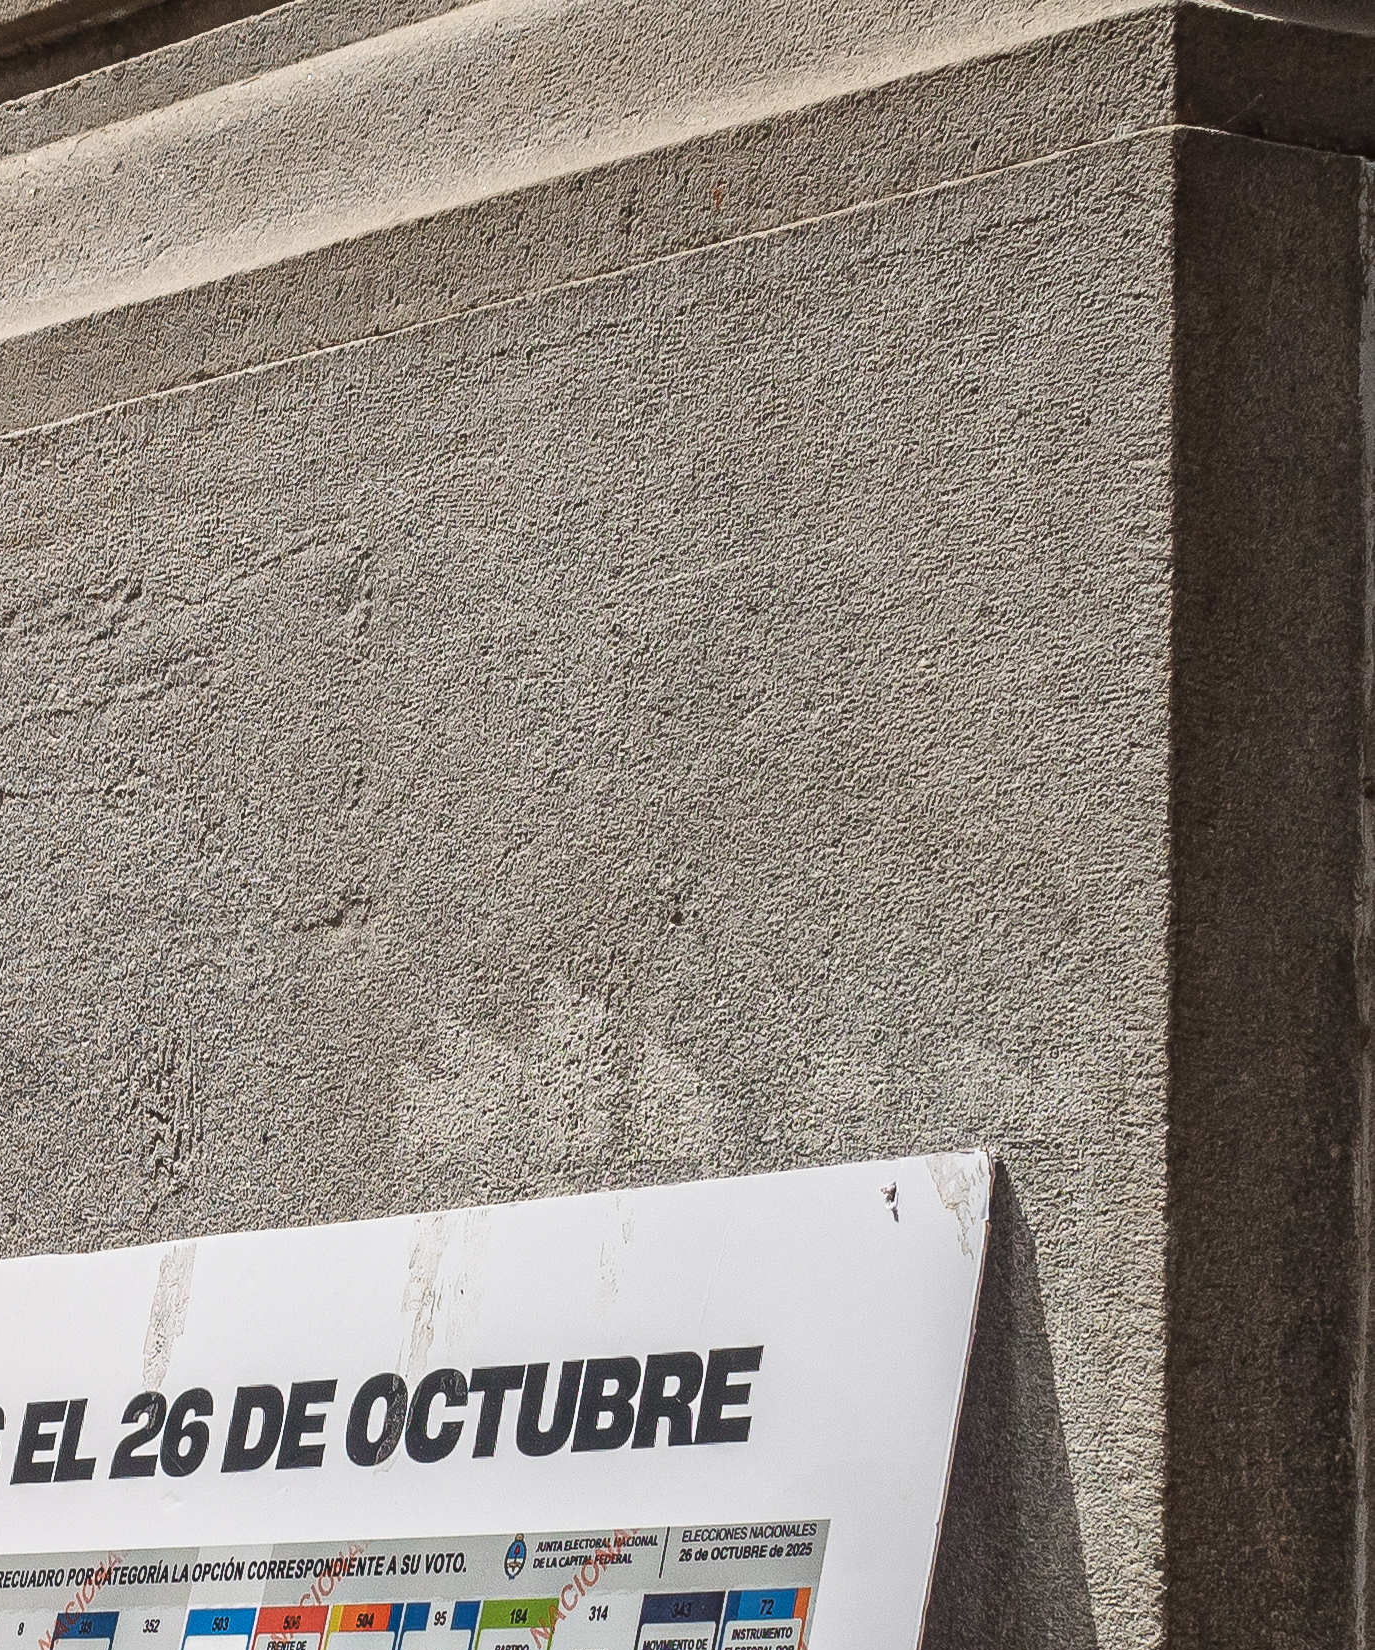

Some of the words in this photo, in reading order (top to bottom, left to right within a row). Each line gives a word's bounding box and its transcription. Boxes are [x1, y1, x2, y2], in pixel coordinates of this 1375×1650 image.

[10, 1398, 97, 1485] EL
[109, 1387, 214, 1480] 26
[221, 1378, 338, 1474] DE
[346, 1345, 764, 1467] OCTUBRE
[682, 1527, 748, 1543] ELECCIONES
[749, 1523, 817, 1539] NACIONALES
[536, 1540, 563, 1553] JUNTA
[564, 1537, 612, 1551] ELECTORAL
[679, 1549, 693, 1562] 26
[694, 1548, 710, 1560] de
[711, 1545, 767, 1560] OCTUBRE
[769, 1544, 783, 1557] de
[784, 1542, 813, 1557] 2025
[558, 1554, 594, 1567] CAPITAL
[594, 1552, 633, 1566] FEDERAL
[66, 1566, 93, 1587] POR
[93, 1560, 169, 1585] CATEGORÍA
[171, 1564, 189, 1583] LA
[191, 1556, 243, 1582] OPCIÓN
[248, 1555, 386, 1580] CORRESPONDIENTE
[400, 1554, 421, 1575] SU
[425, 1552, 467, 1574] VOTO.
[433, 1609, 448, 1626] 95
[508, 1607, 528, 1625] 184
[588, 1604, 609, 1622] 314
[142, 1618, 161, 1634] 352
[211, 1615, 230, 1632] 503
[731, 1626, 793, 1641] INSTRUMENTO
